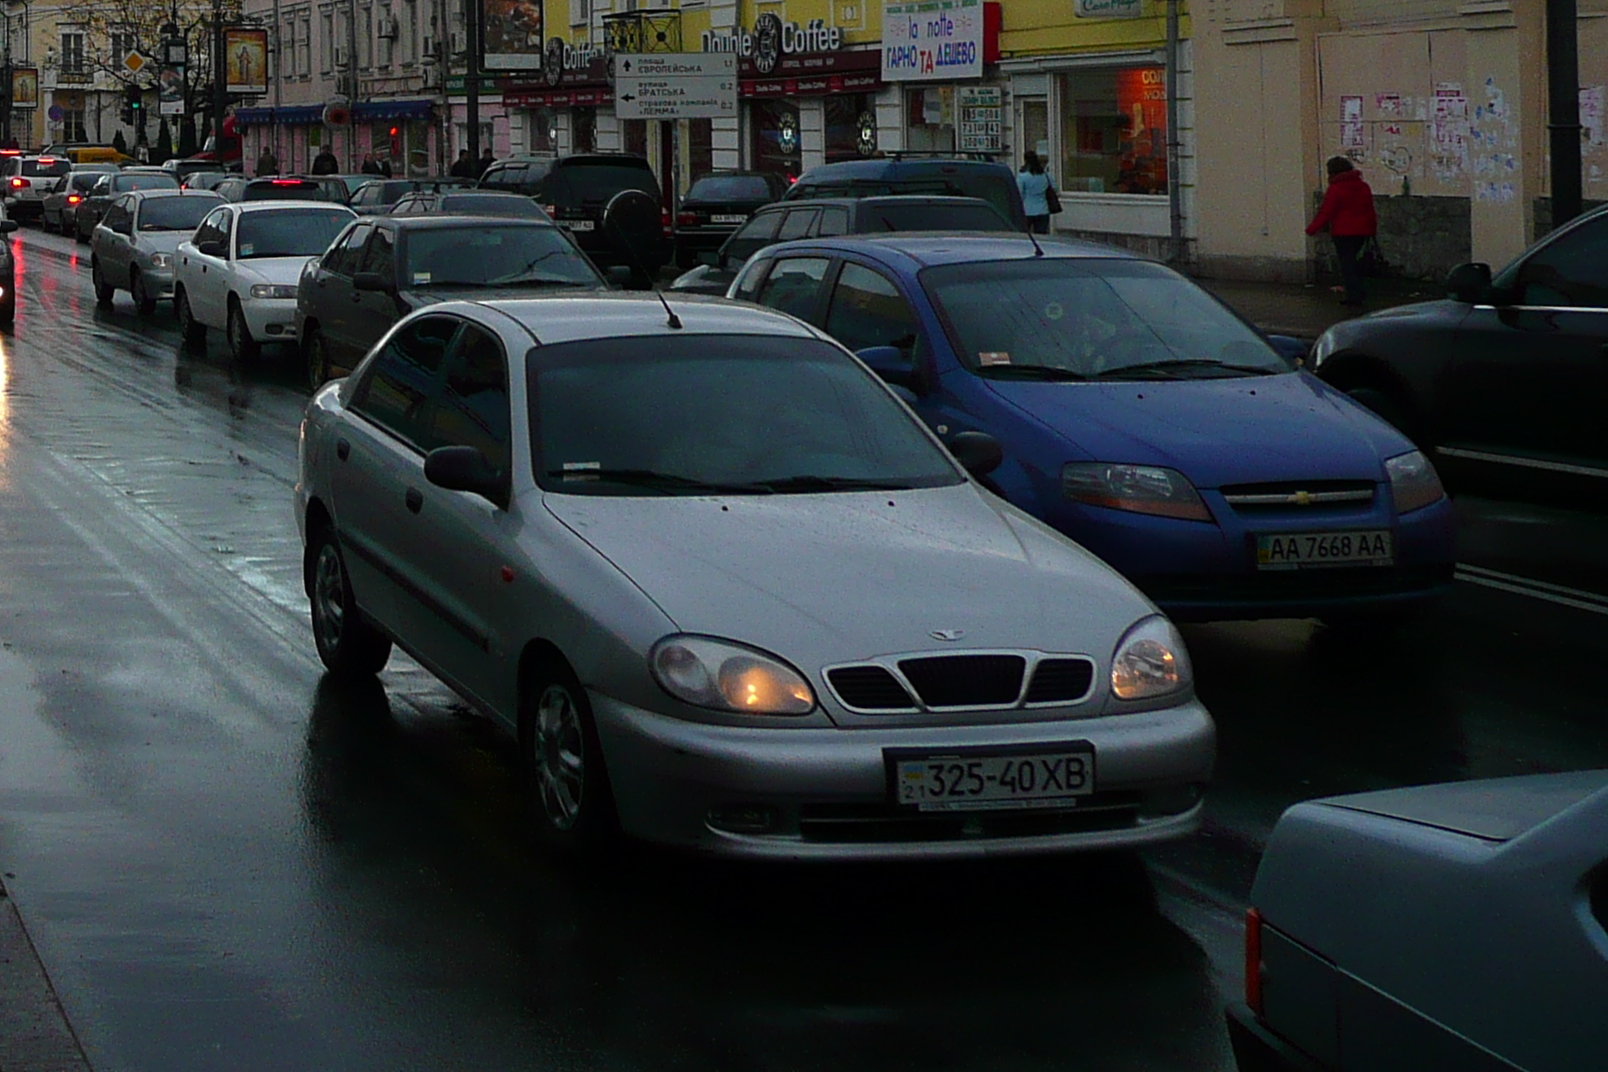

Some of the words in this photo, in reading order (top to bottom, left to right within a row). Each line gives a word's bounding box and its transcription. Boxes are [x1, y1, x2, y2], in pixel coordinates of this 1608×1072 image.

[782, 20, 840, 53] Coffee
[638, 65, 702, 74] ЄВРОПЕЙСЬКА
[887, 45, 917, 68] ГАРНО
[920, 50, 933, 74] ТА
[936, 41, 976, 66] ДЕШЕВО
[638, 89, 685, 97] БРАТСЬКА
[1271, 538, 1300, 560] AA
[1305, 536, 1352, 558] 7668
[1358, 534, 1386, 556] AA
